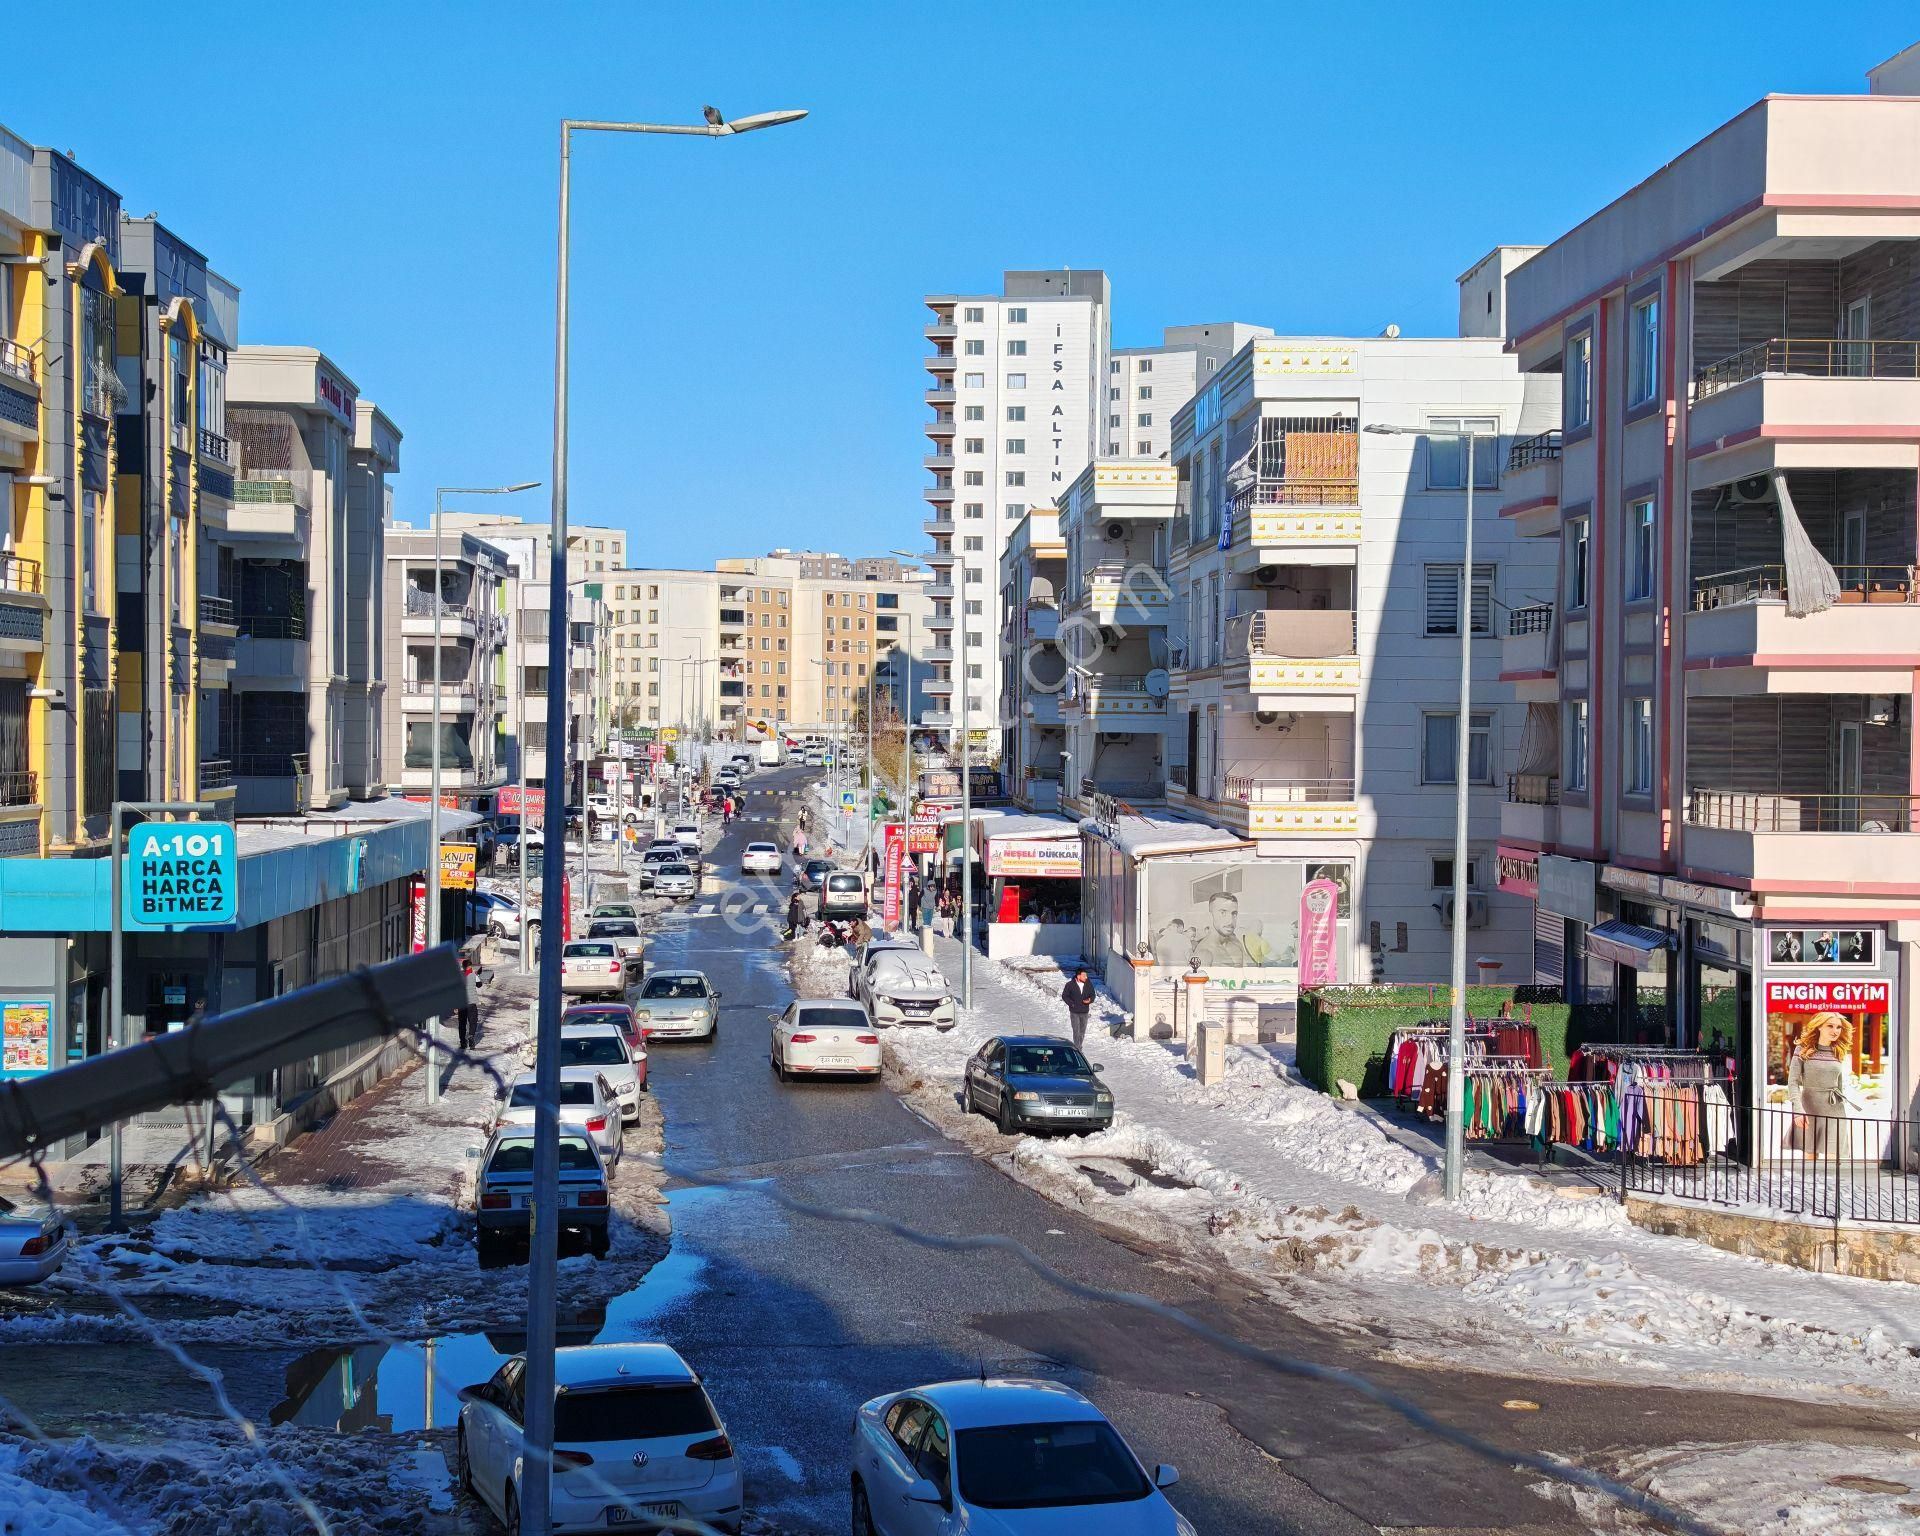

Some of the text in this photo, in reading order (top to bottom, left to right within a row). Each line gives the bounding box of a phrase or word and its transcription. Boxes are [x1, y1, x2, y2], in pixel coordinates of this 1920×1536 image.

[1051, 323, 1064, 482] İFŞA ALTIN
[440, 852, 474, 862] KNUR
[1003, 847, 1079, 859] NEŞELİ DÜKKAN
[142, 860, 222, 876] HARCA
[142, 878, 222, 895] HARCA
